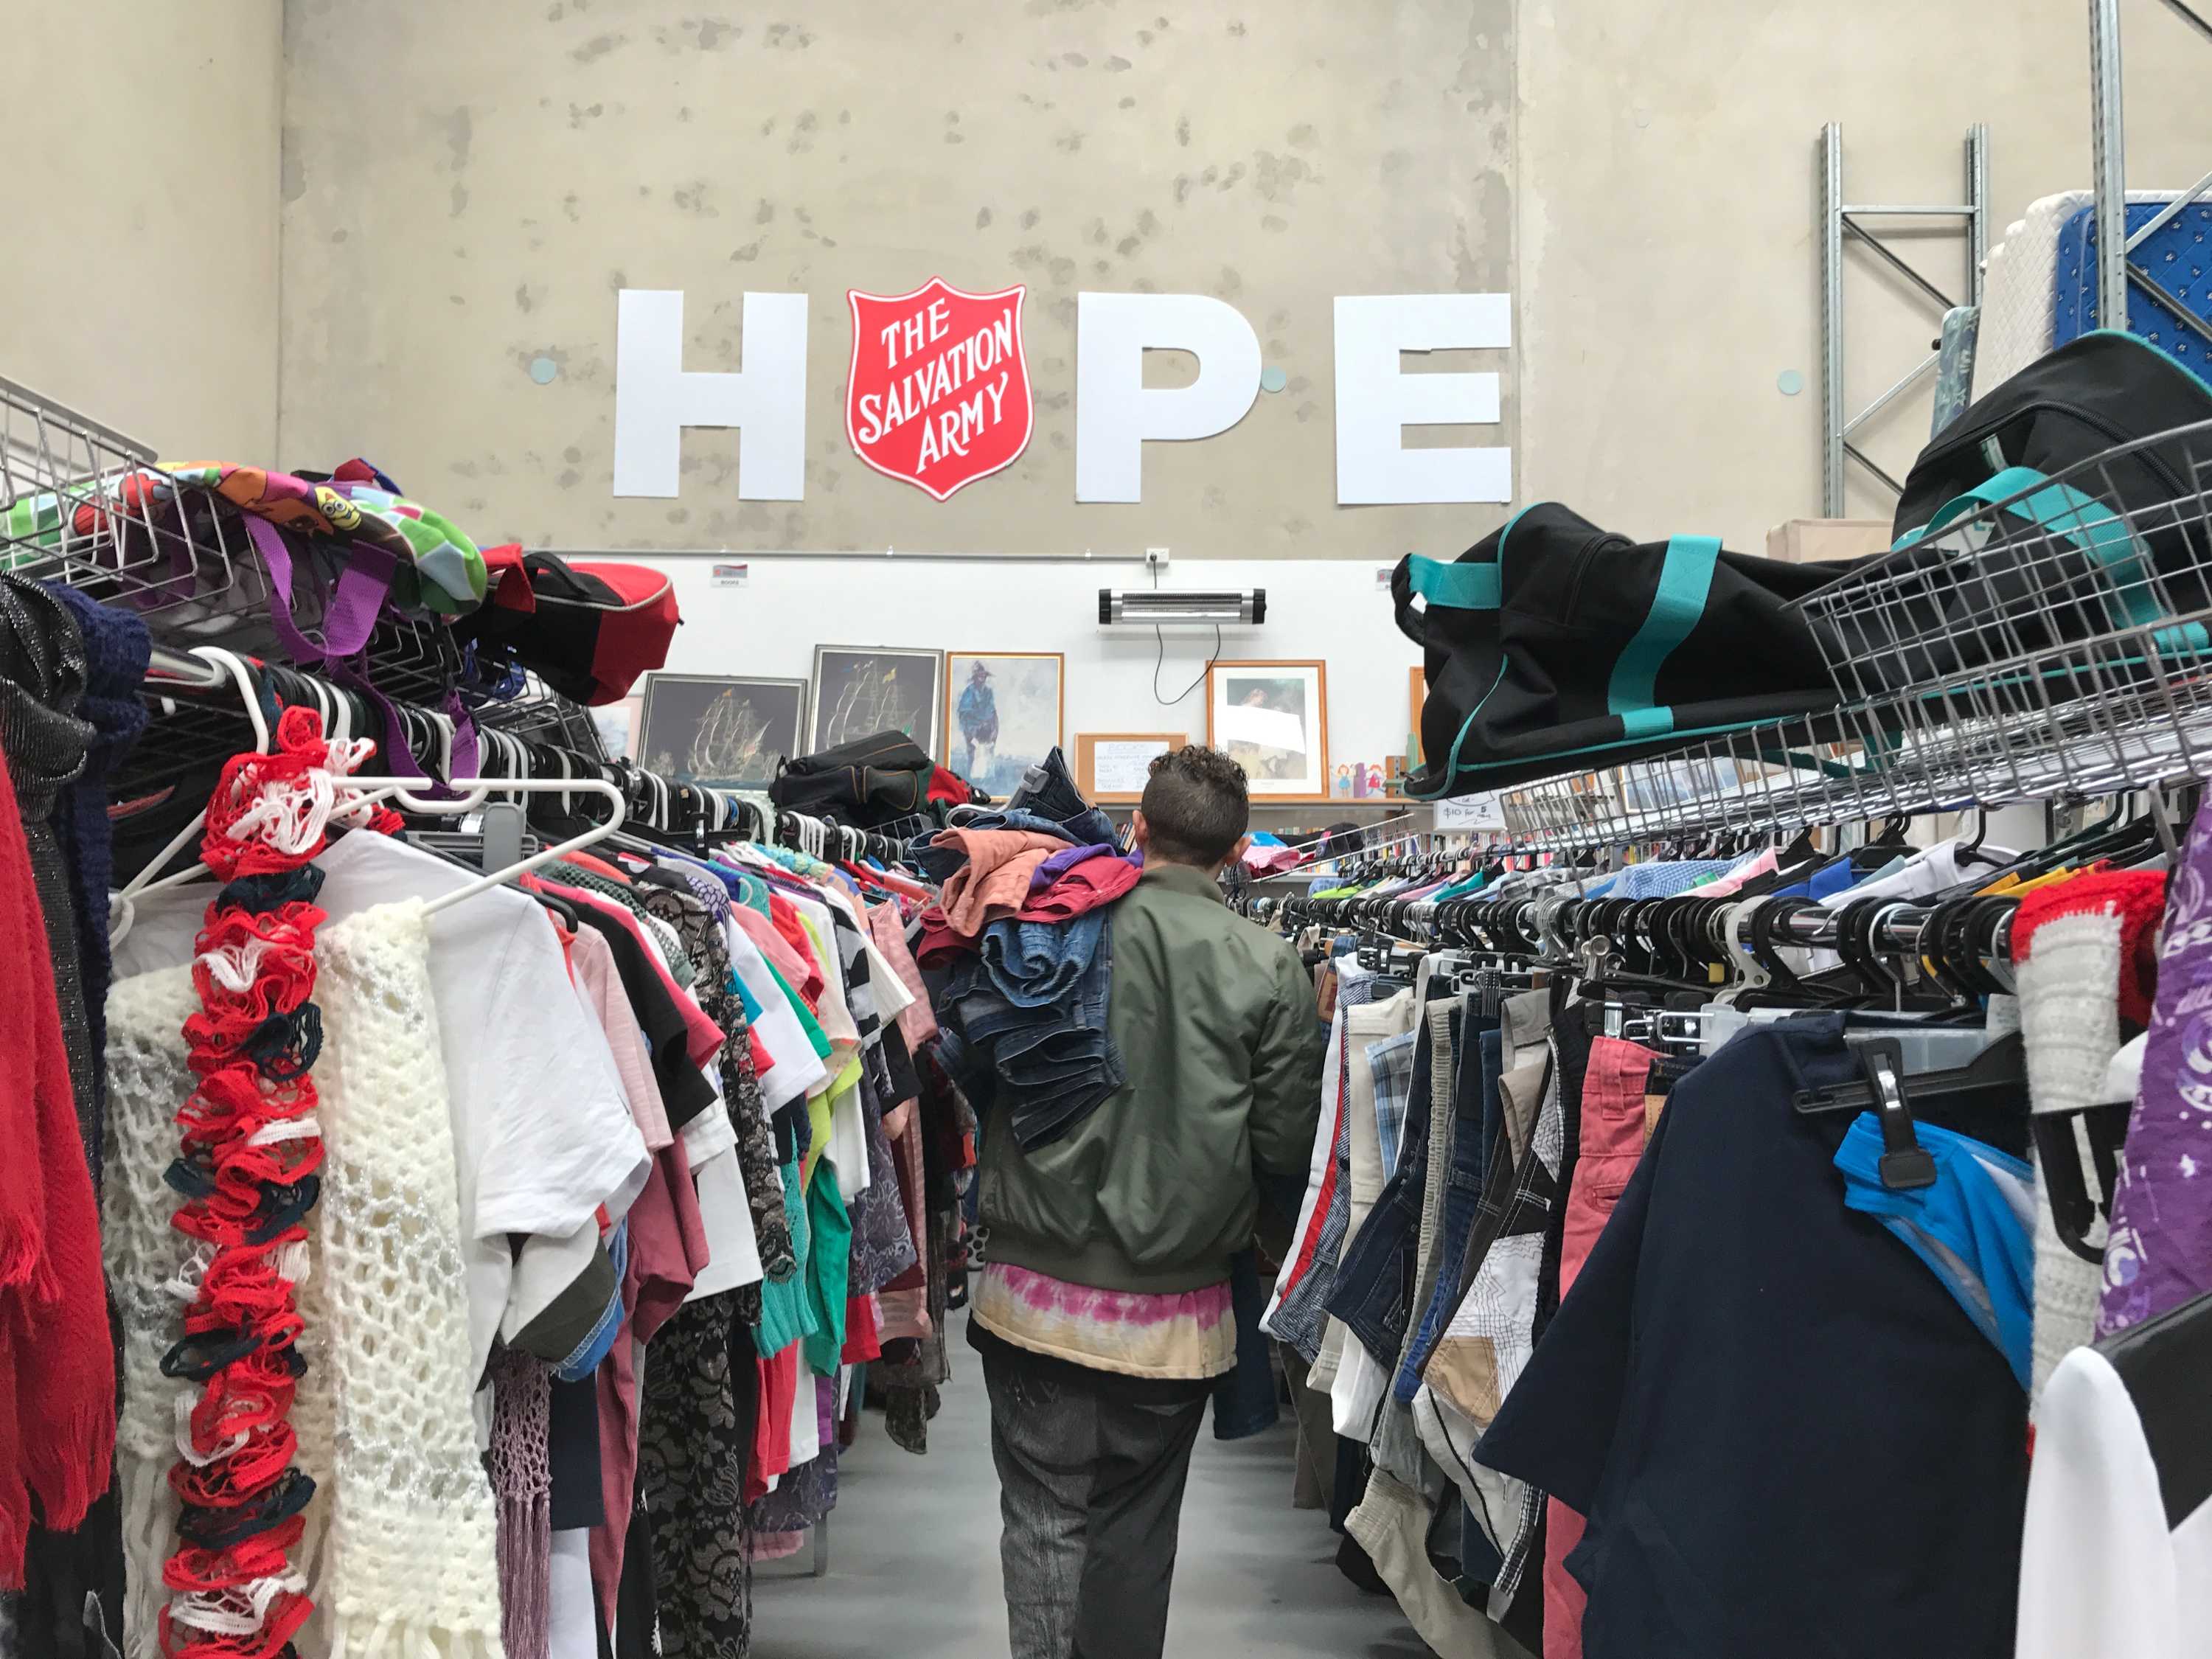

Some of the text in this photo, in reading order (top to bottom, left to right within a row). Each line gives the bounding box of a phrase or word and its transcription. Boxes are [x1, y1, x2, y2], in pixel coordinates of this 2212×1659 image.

[858, 308, 1012, 444] SALVATION
[881, 297, 950, 369] THE
[613, 289, 809, 501] H
[916, 372, 1009, 475] ARMY
[1443, 807, 1461, 819] $10
